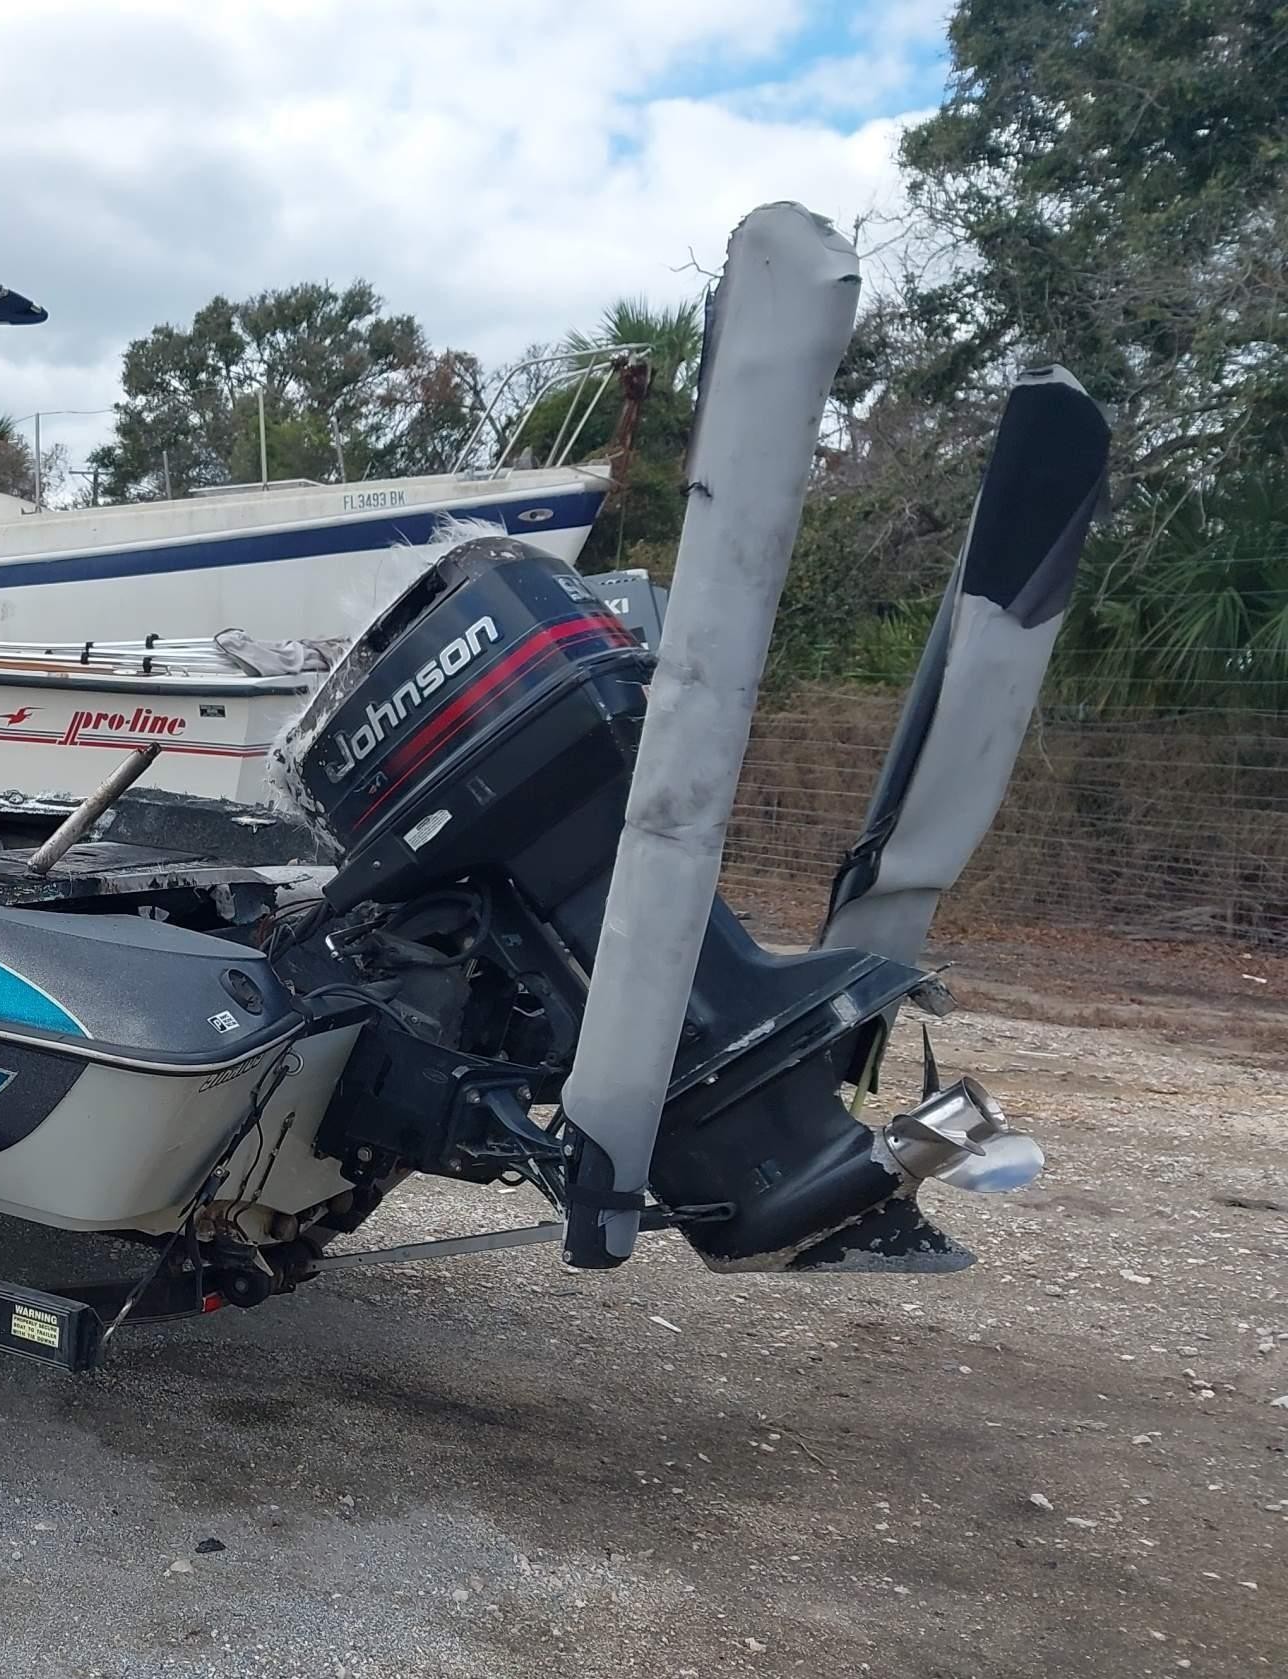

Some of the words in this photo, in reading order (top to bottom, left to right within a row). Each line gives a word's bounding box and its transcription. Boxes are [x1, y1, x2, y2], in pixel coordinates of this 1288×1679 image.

[344, 495, 357, 509] FL
[358, 492, 386, 509] 3493
[390, 490, 406, 505] BK
[324, 616, 499, 784] Johnson
[56, 708, 186, 746] pro-line
[15, 1304, 58, 1325] WARNING
[13, 1322, 26, 1330] BOAT
[36, 1329, 57, 1339] TRAILER
